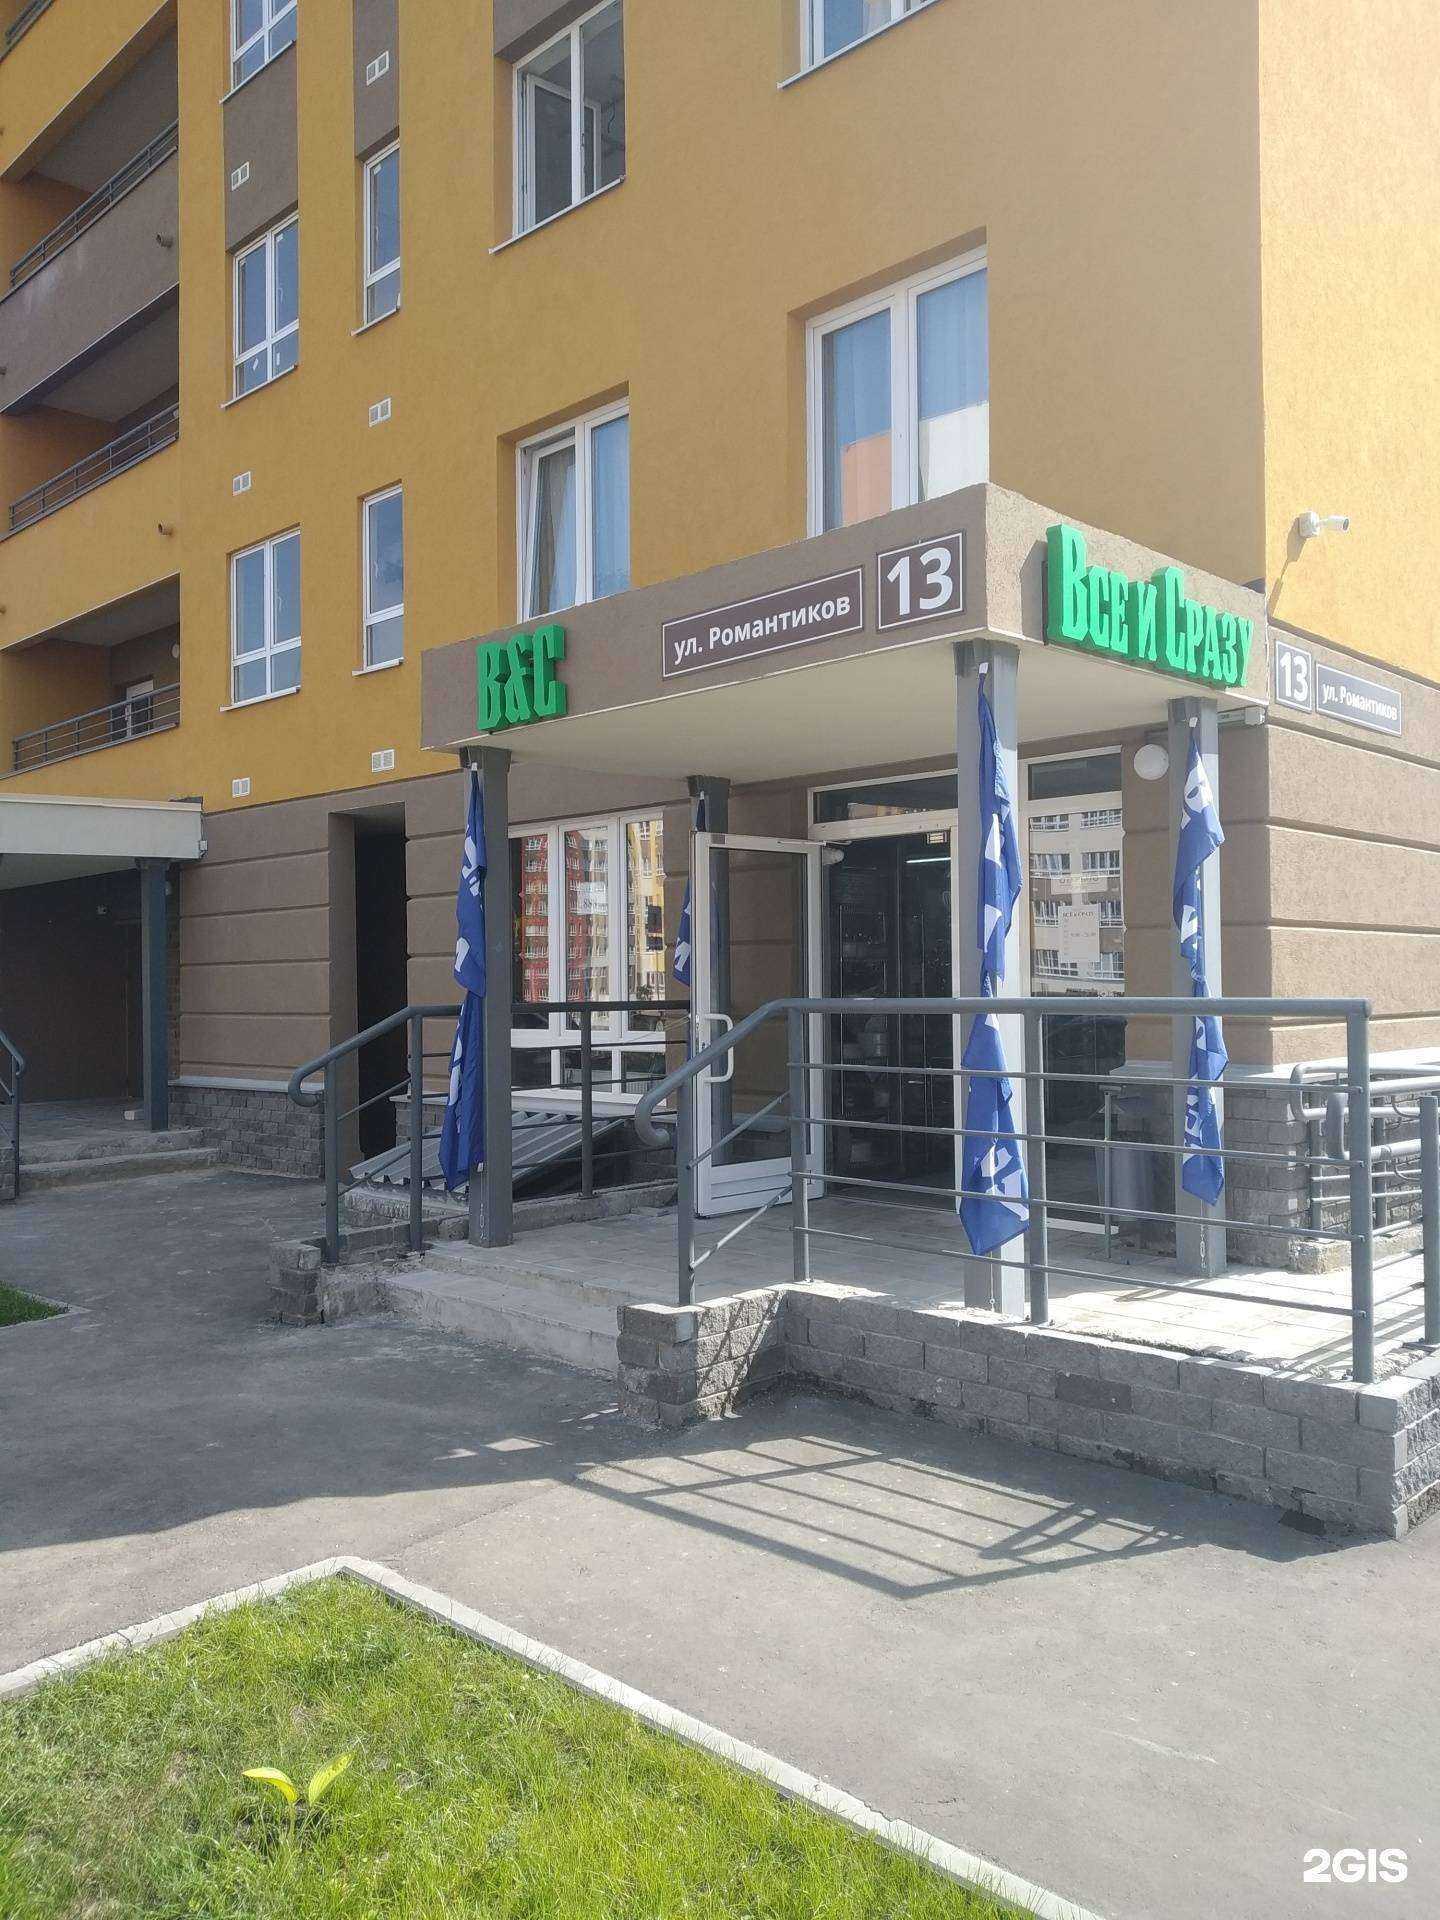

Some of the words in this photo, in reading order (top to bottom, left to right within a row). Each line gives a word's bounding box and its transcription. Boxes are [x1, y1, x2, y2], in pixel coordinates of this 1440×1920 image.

[886, 546, 954, 617] 13
[673, 636, 704, 667] ул.
[708, 595, 852, 650] Романтиков
[1279, 651, 1309, 702] 13
[1321, 683, 1338, 705] ул.
[1339, 685, 1398, 721] Романтиков
